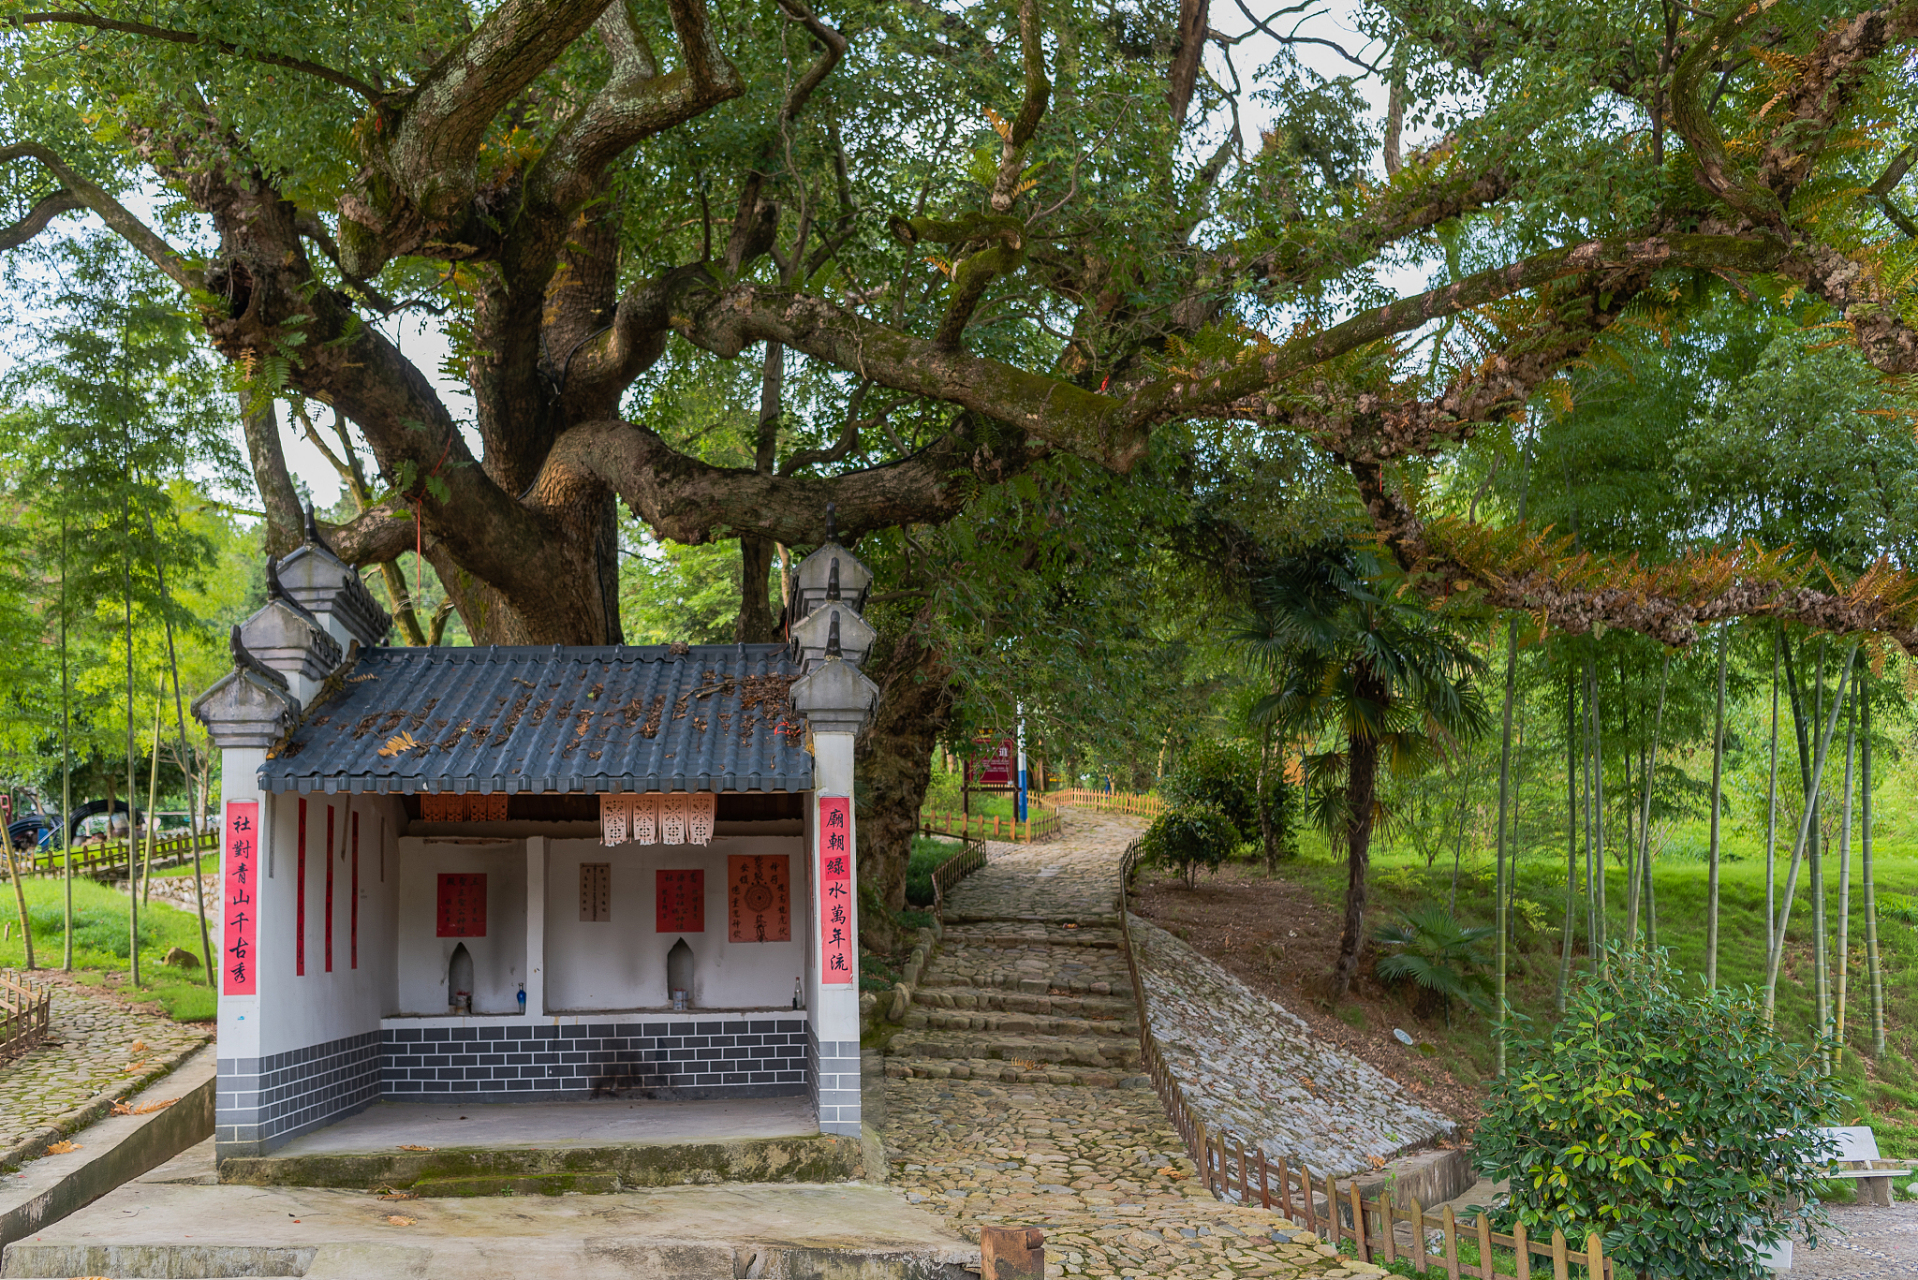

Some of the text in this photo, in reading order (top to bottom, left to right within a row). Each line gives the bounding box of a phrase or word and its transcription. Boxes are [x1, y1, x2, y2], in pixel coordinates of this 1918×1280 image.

[229, 816, 252, 984] 社對青山千古秀
